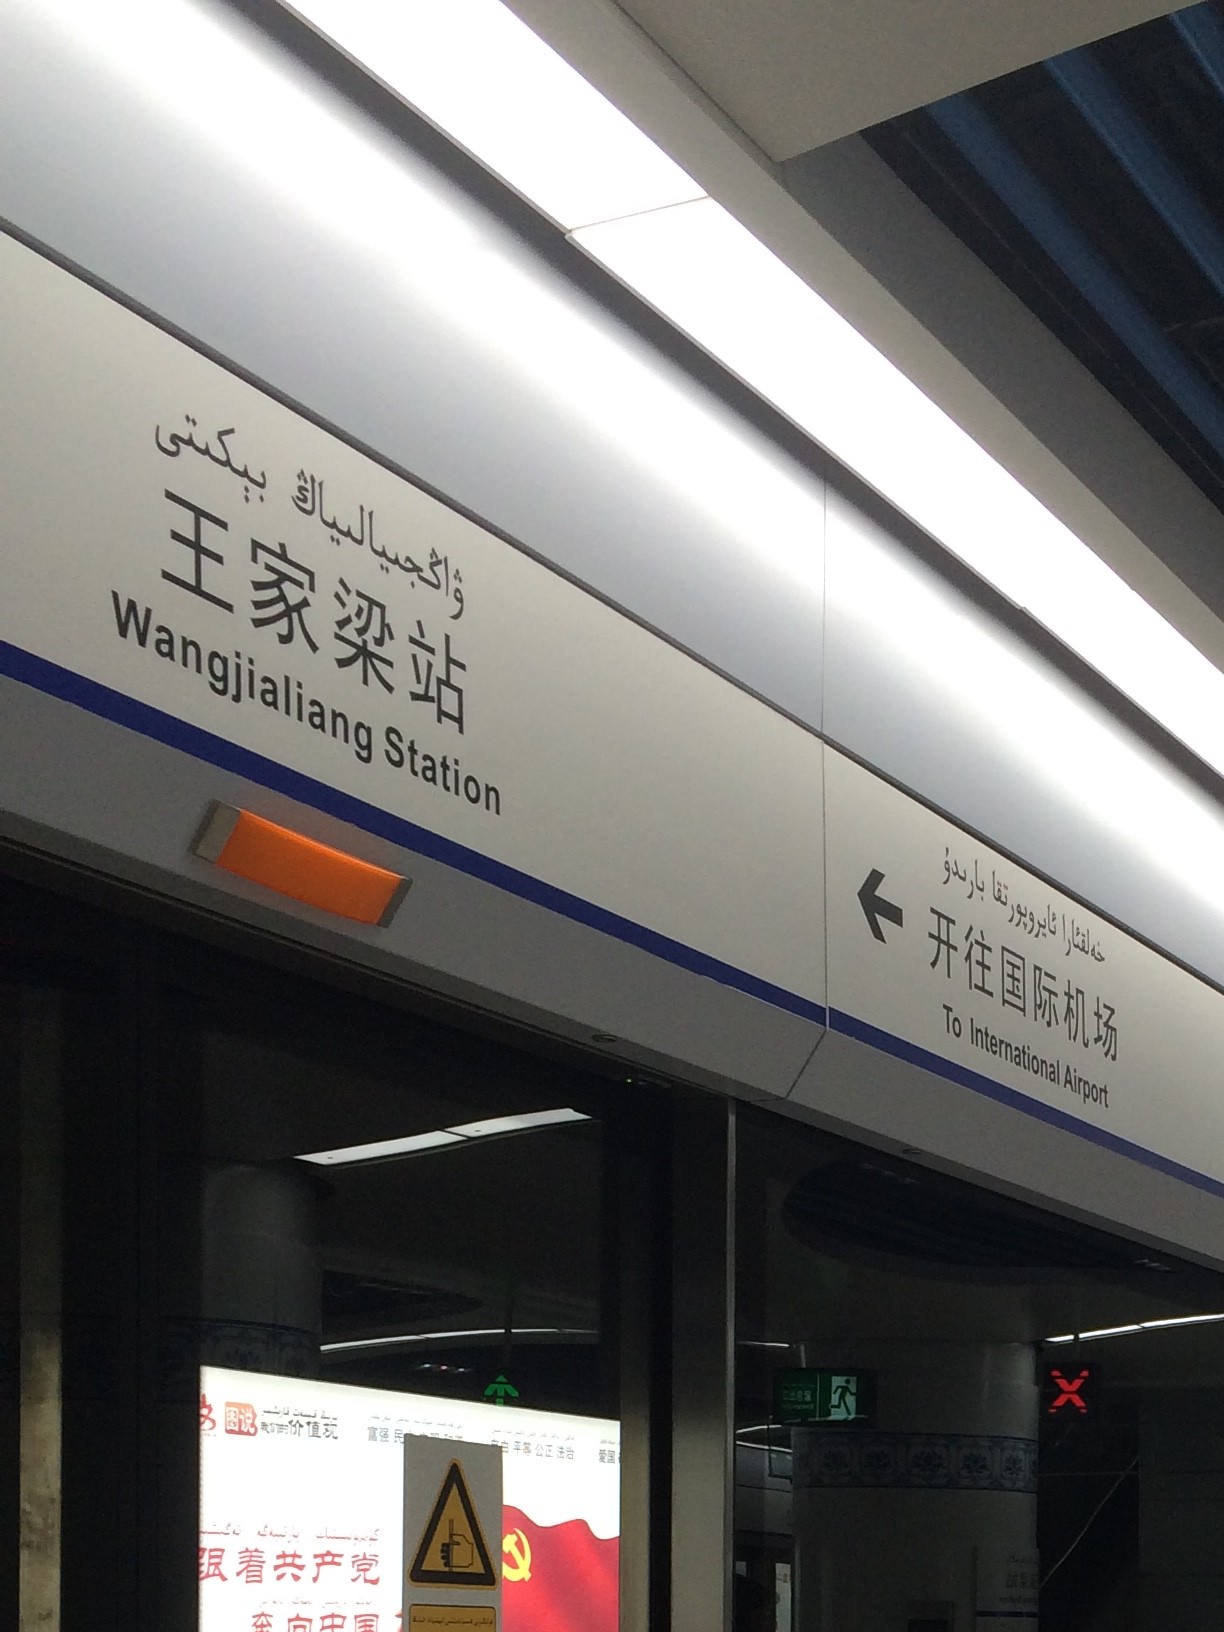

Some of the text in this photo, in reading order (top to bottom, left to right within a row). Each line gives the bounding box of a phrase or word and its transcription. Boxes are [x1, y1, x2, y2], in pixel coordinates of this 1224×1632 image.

[111, 589, 500, 815] Wangjialiang Station
[161, 488, 467, 735] 王家梁站
[928, 906, 1117, 1062] 开往国际机场
[943, 1003, 1109, 1108] To International Airport
